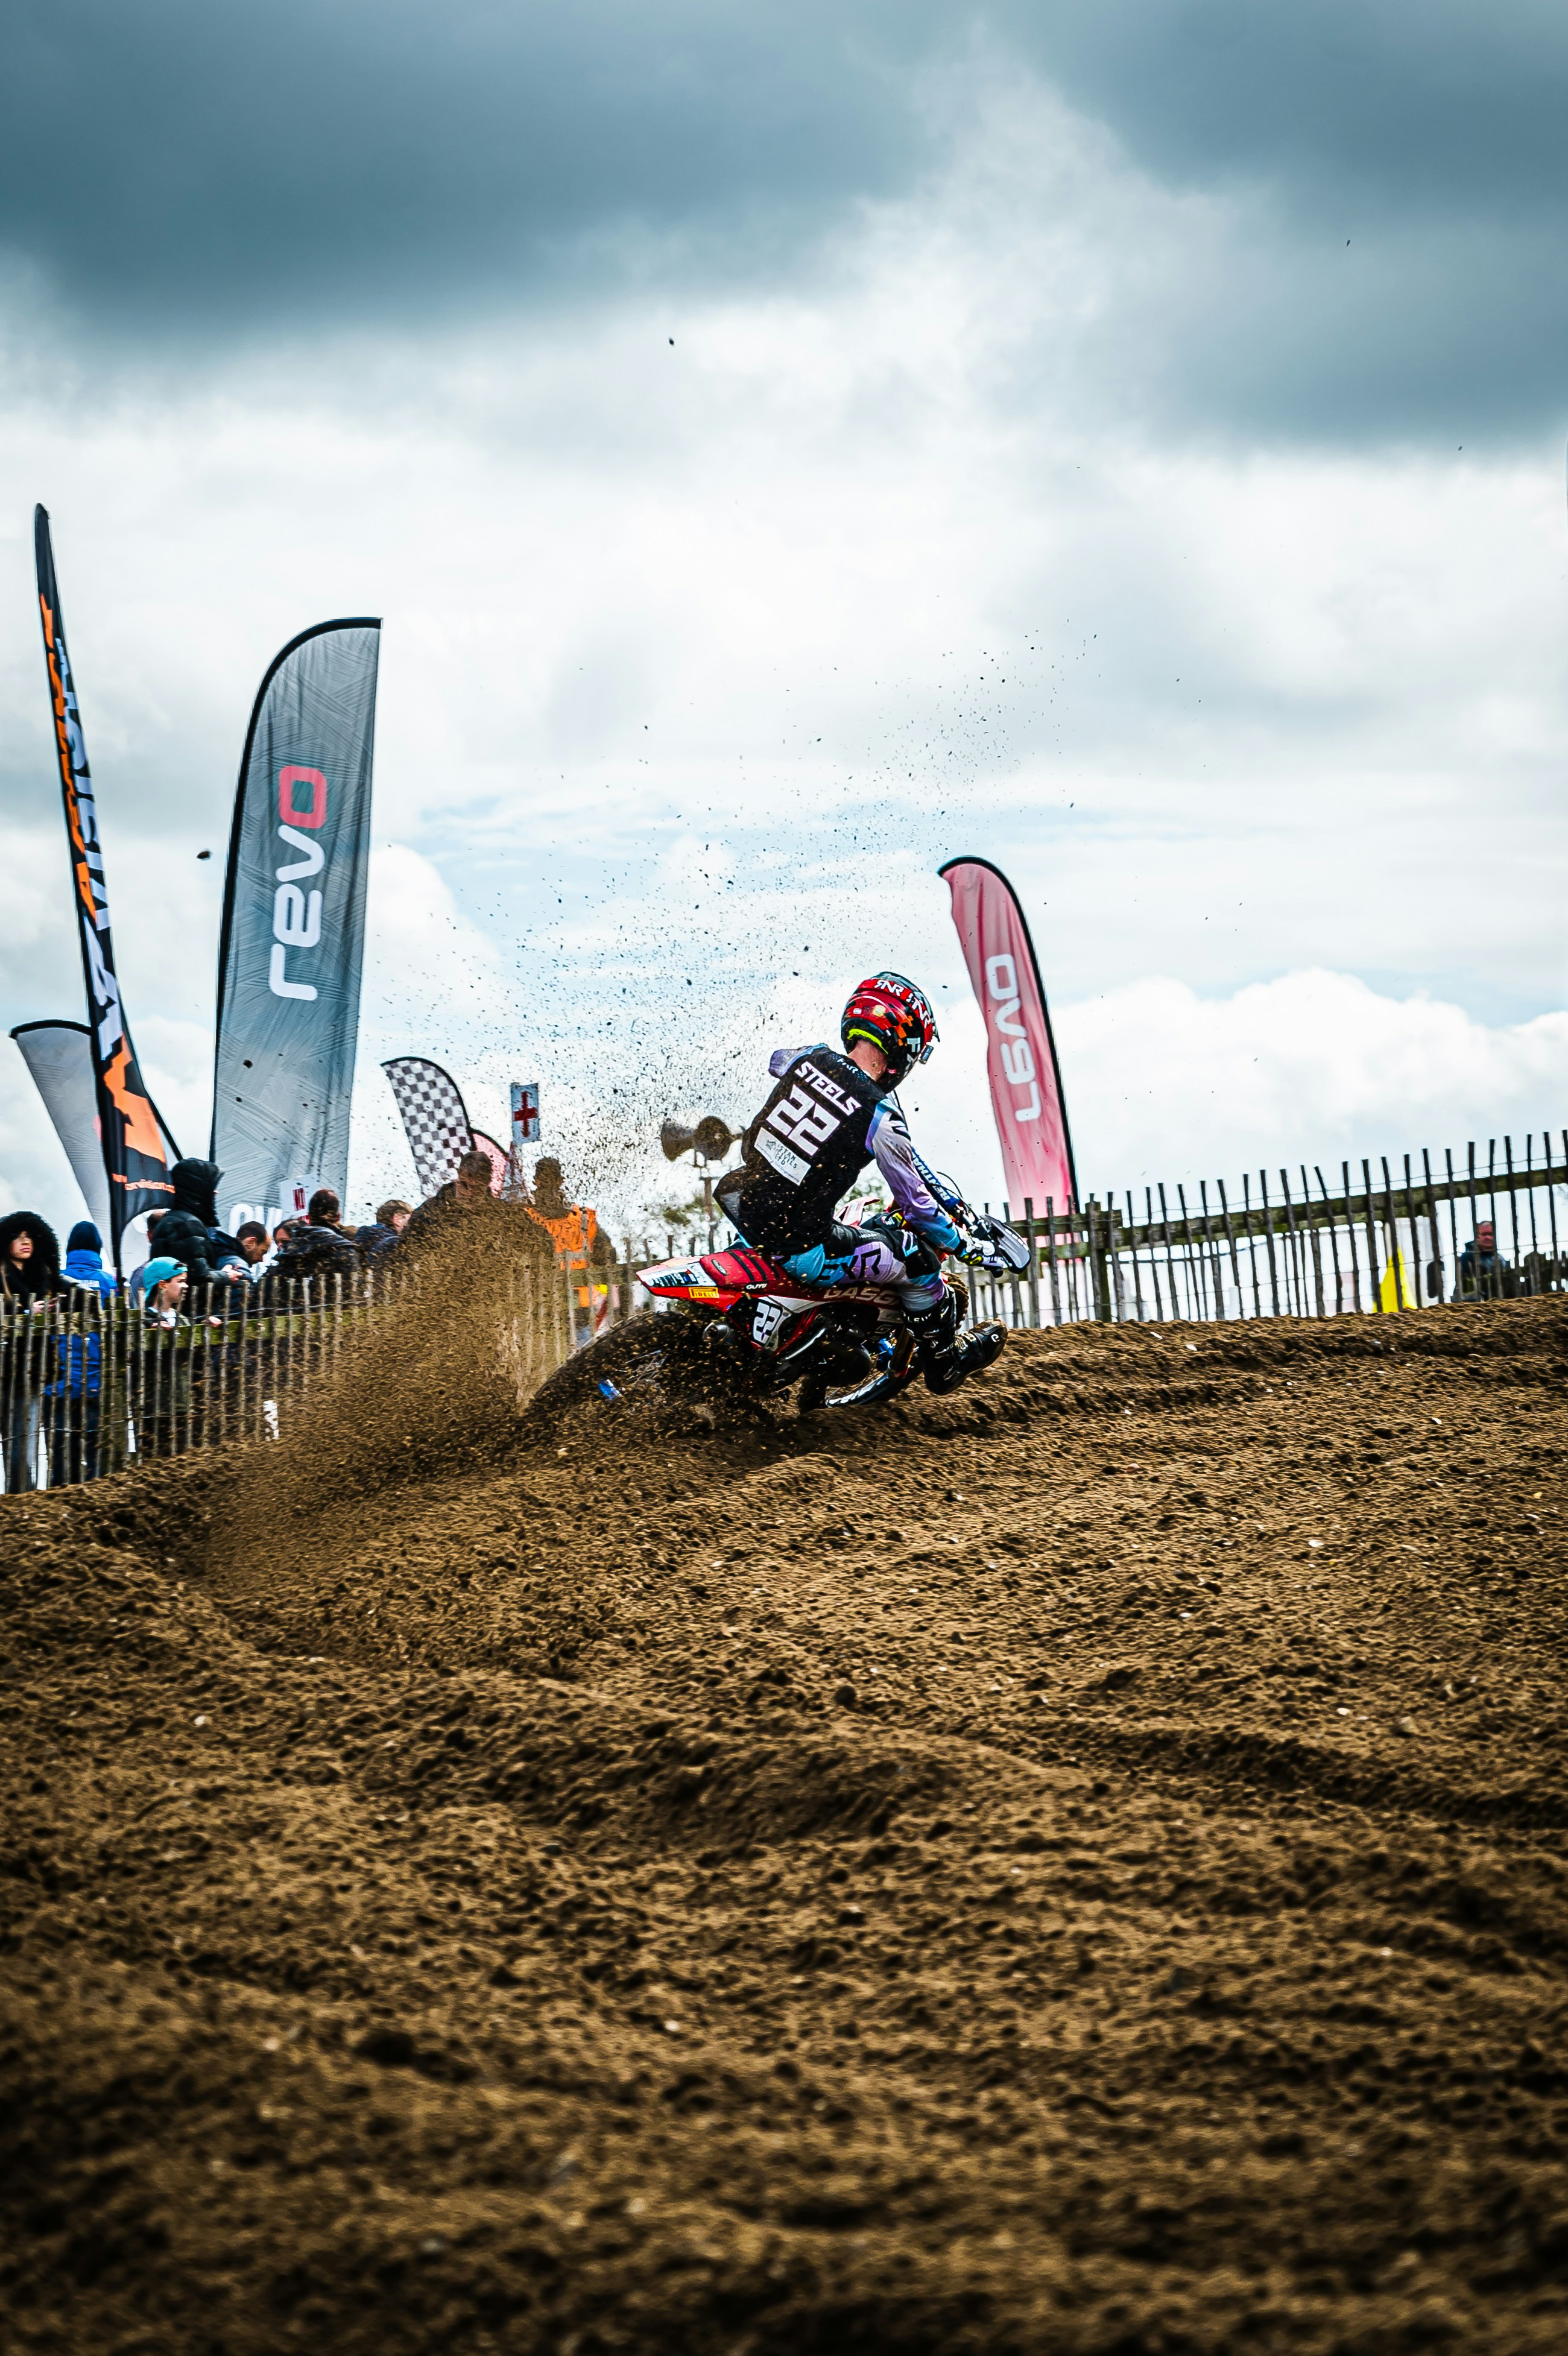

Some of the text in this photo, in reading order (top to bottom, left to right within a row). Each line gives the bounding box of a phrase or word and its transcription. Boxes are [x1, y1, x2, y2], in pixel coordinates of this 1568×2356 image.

[267, 765, 328, 1002] revo
[794, 1061, 862, 1116] STEELS
[766, 1084, 841, 1156] 22
[753, 1302, 781, 1344] 22
[823, 1286, 900, 1306] GASG
